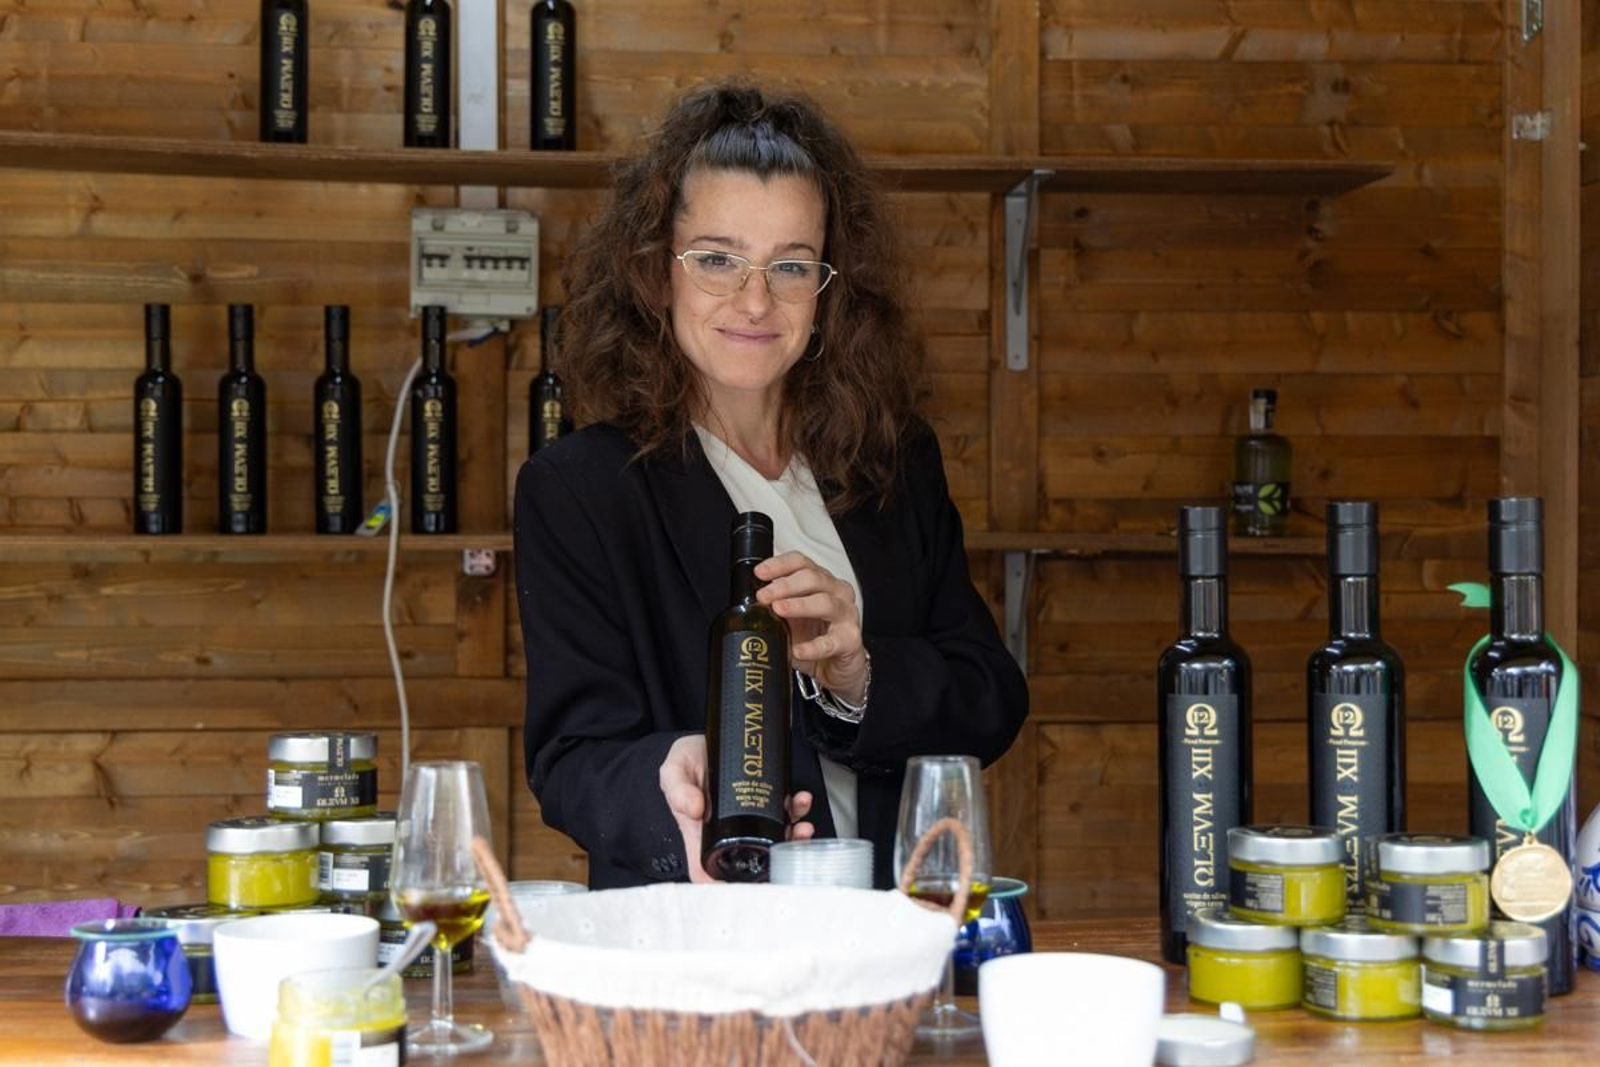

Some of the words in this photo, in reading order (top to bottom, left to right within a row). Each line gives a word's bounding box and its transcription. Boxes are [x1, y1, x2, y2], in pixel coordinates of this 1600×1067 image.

[745, 669, 764, 694] XII
[1192, 747, 1214, 781] XII
[1336, 749, 1359, 782] XII
